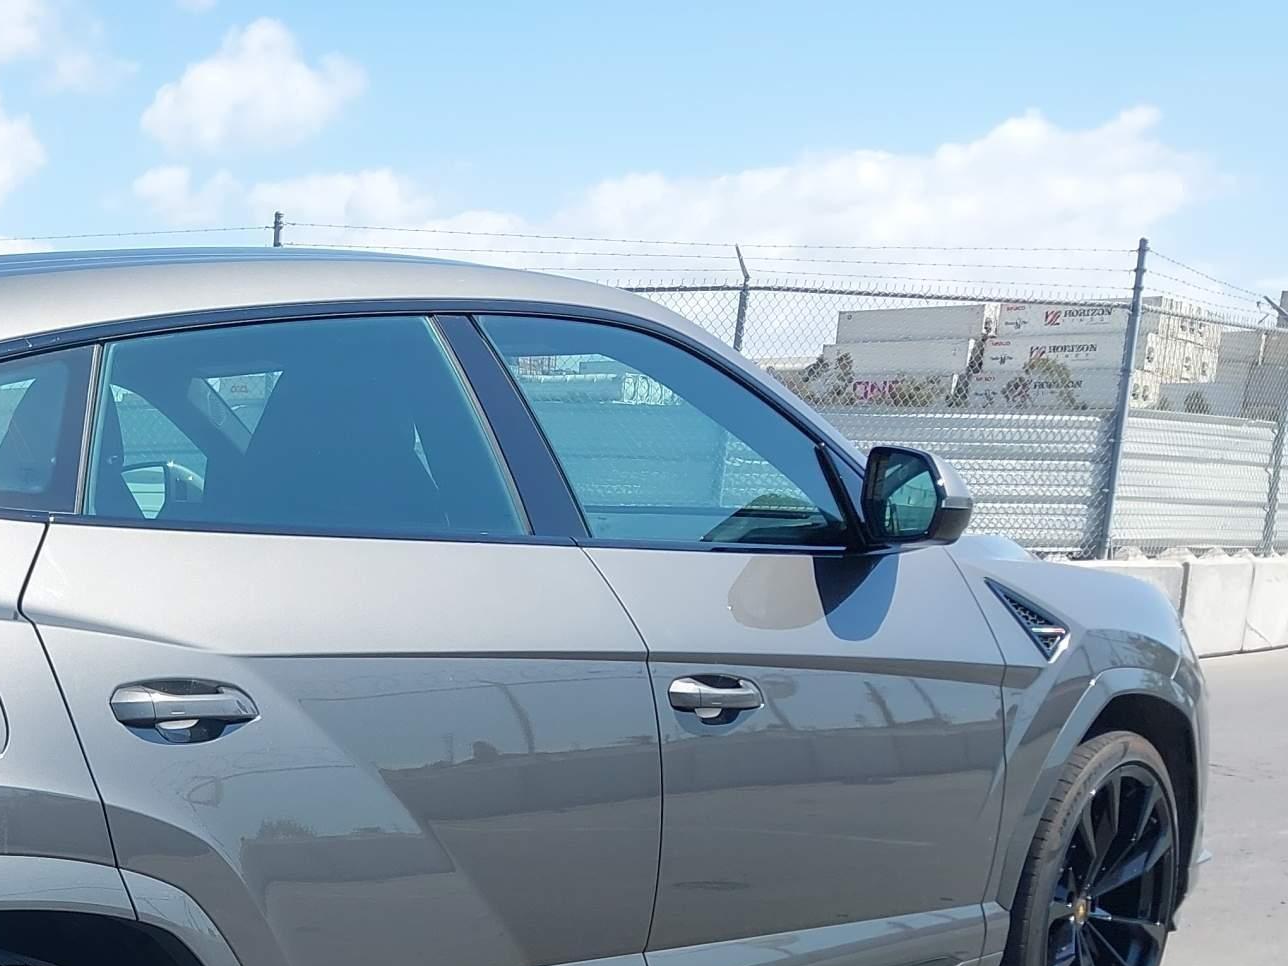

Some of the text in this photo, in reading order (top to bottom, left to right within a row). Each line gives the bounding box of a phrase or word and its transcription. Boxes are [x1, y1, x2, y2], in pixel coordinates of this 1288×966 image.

[1064, 307, 1113, 318] HORIZON
[1048, 343, 1098, 354] HORIZON
[1033, 380, 1083, 390] HOON
